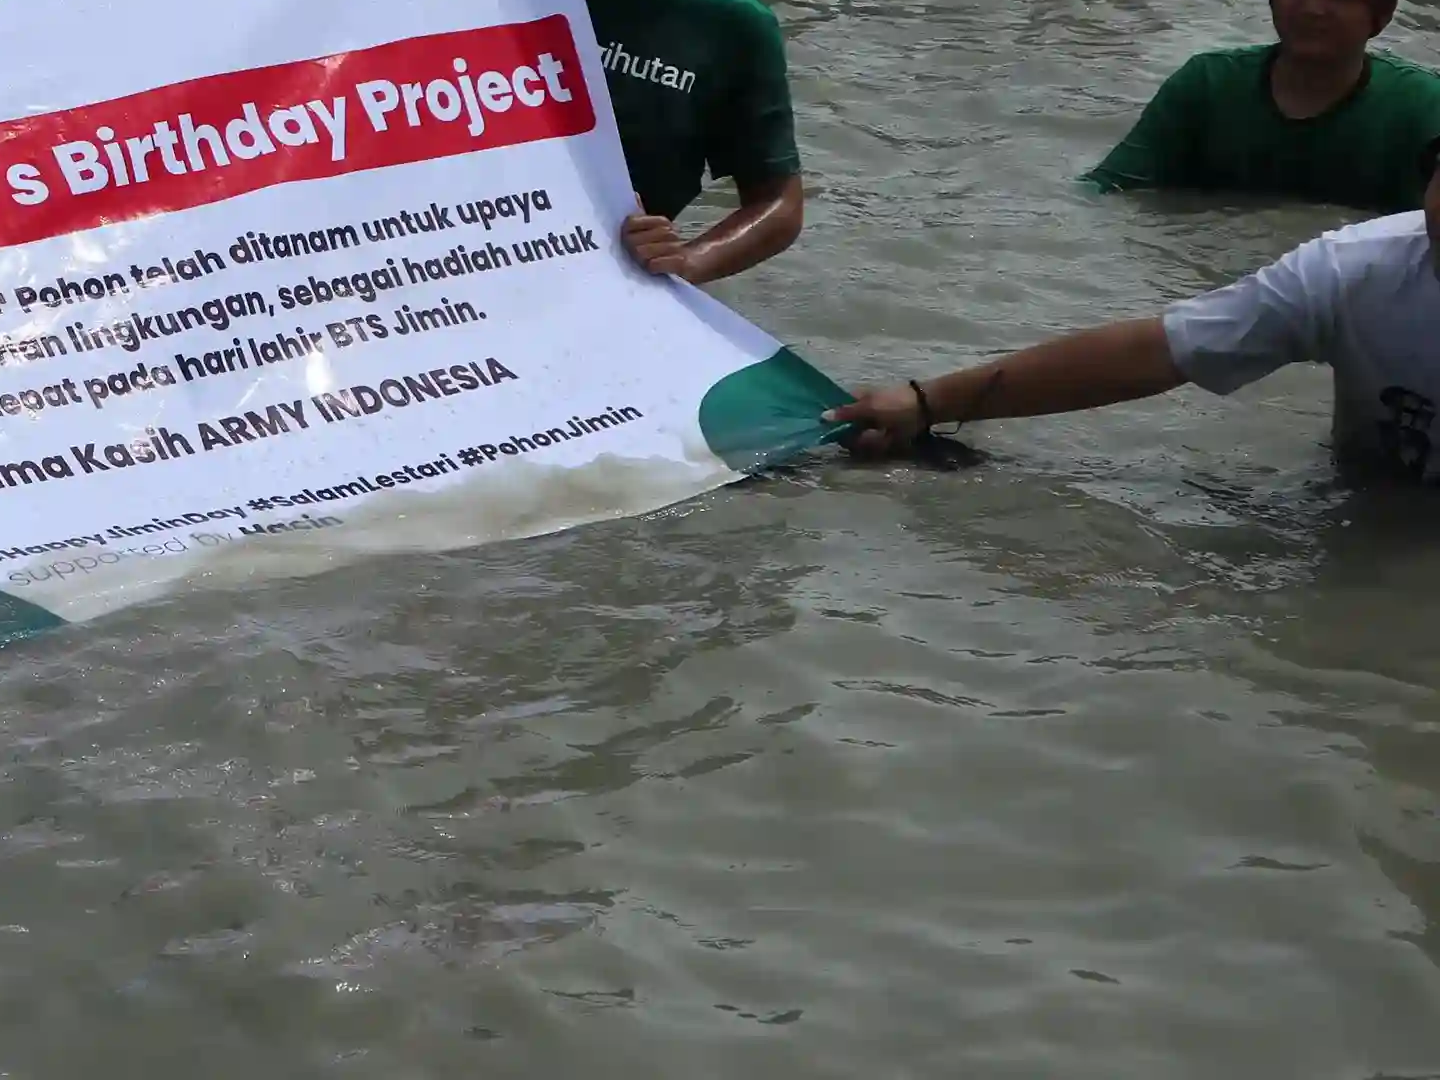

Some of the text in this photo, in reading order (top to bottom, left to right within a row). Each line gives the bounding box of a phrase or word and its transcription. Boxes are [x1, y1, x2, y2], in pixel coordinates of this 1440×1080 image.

[52, 96, 347, 196] Birthday
[355, 52, 573, 137] Project
[15, 271, 127, 314] Pohon
[131, 246, 227, 287] telah
[229, 222, 360, 264] ditanam
[363, 201, 456, 243] untuk
[456, 187, 553, 225] upaya
[72, 291, 276, 353] lingkungan,
[278, 258, 404, 309] sebagai
[402, 243, 512, 288] hadiah
[516, 224, 602, 265] untuk
[69, 426, 194, 475] Kasih
[197, 398, 312, 452] ARMY
[310, 356, 520, 422] INDONESIA
[85, 362, 176, 409] pada
[177, 338, 249, 382] hari
[249, 327, 324, 368] lahir
[325, 313, 390, 351] BTS
[393, 299, 487, 338] Jimin.
[246, 453, 460, 512] #SalamLestari
[458, 403, 644, 468] #PohonJimin
